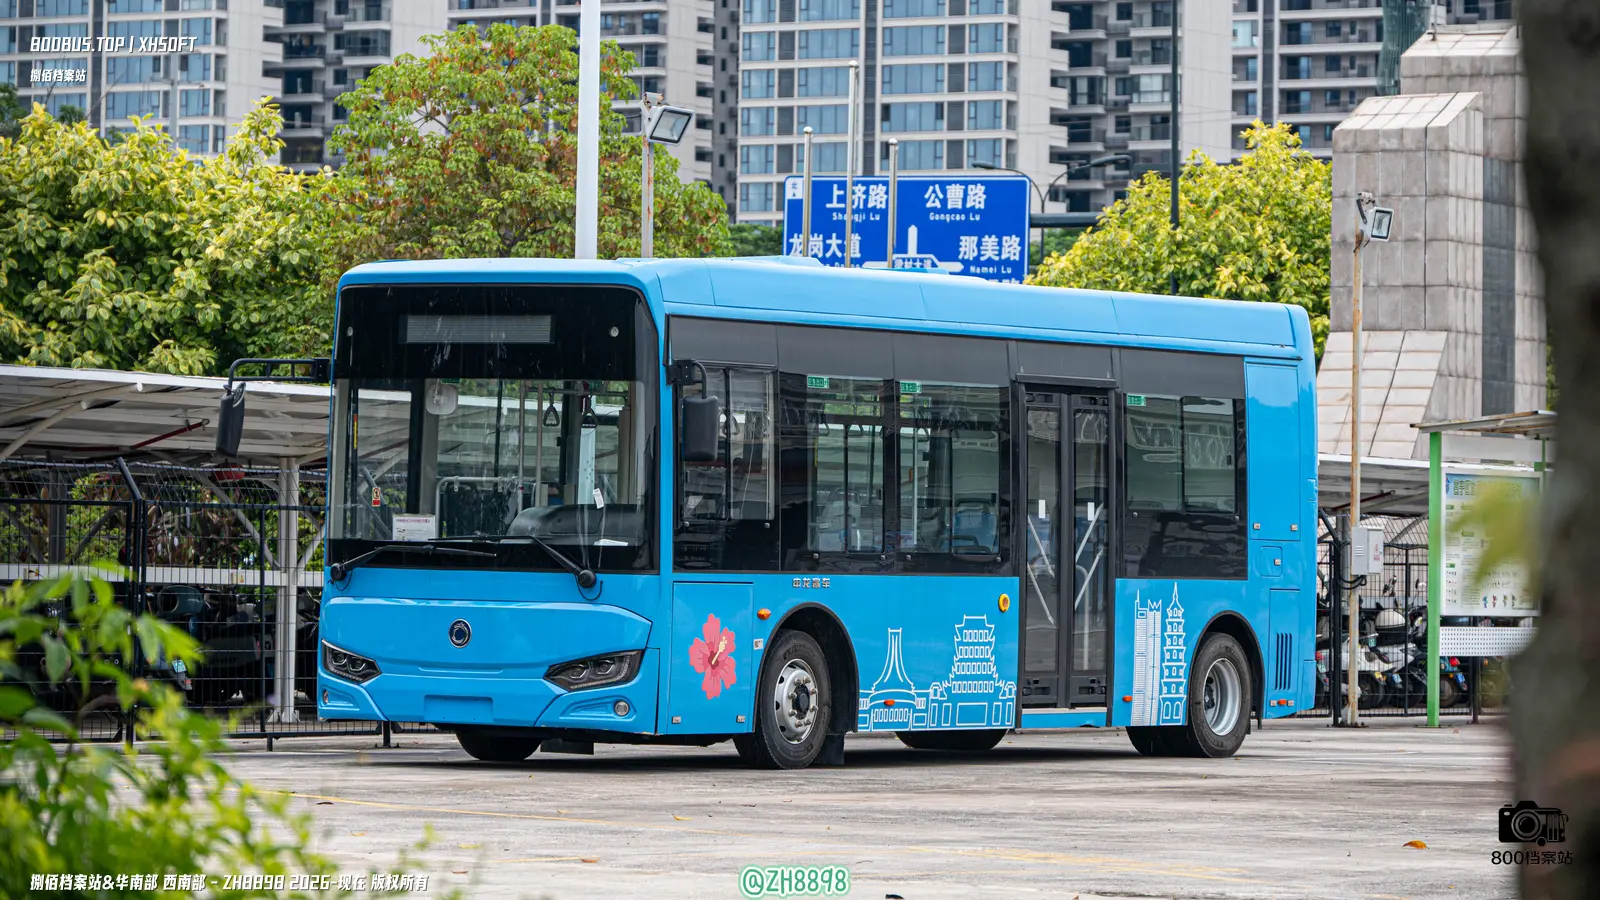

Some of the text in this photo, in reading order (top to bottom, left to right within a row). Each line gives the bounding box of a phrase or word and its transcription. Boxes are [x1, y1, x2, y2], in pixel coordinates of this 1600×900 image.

[924, 183, 987, 209] 公曹路
[869, 211, 881, 221] Lu
[929, 212, 981, 223] Gongcao Lu
[958, 234, 1022, 261] 那美路
[969, 265, 1012, 275] Namei Lu
